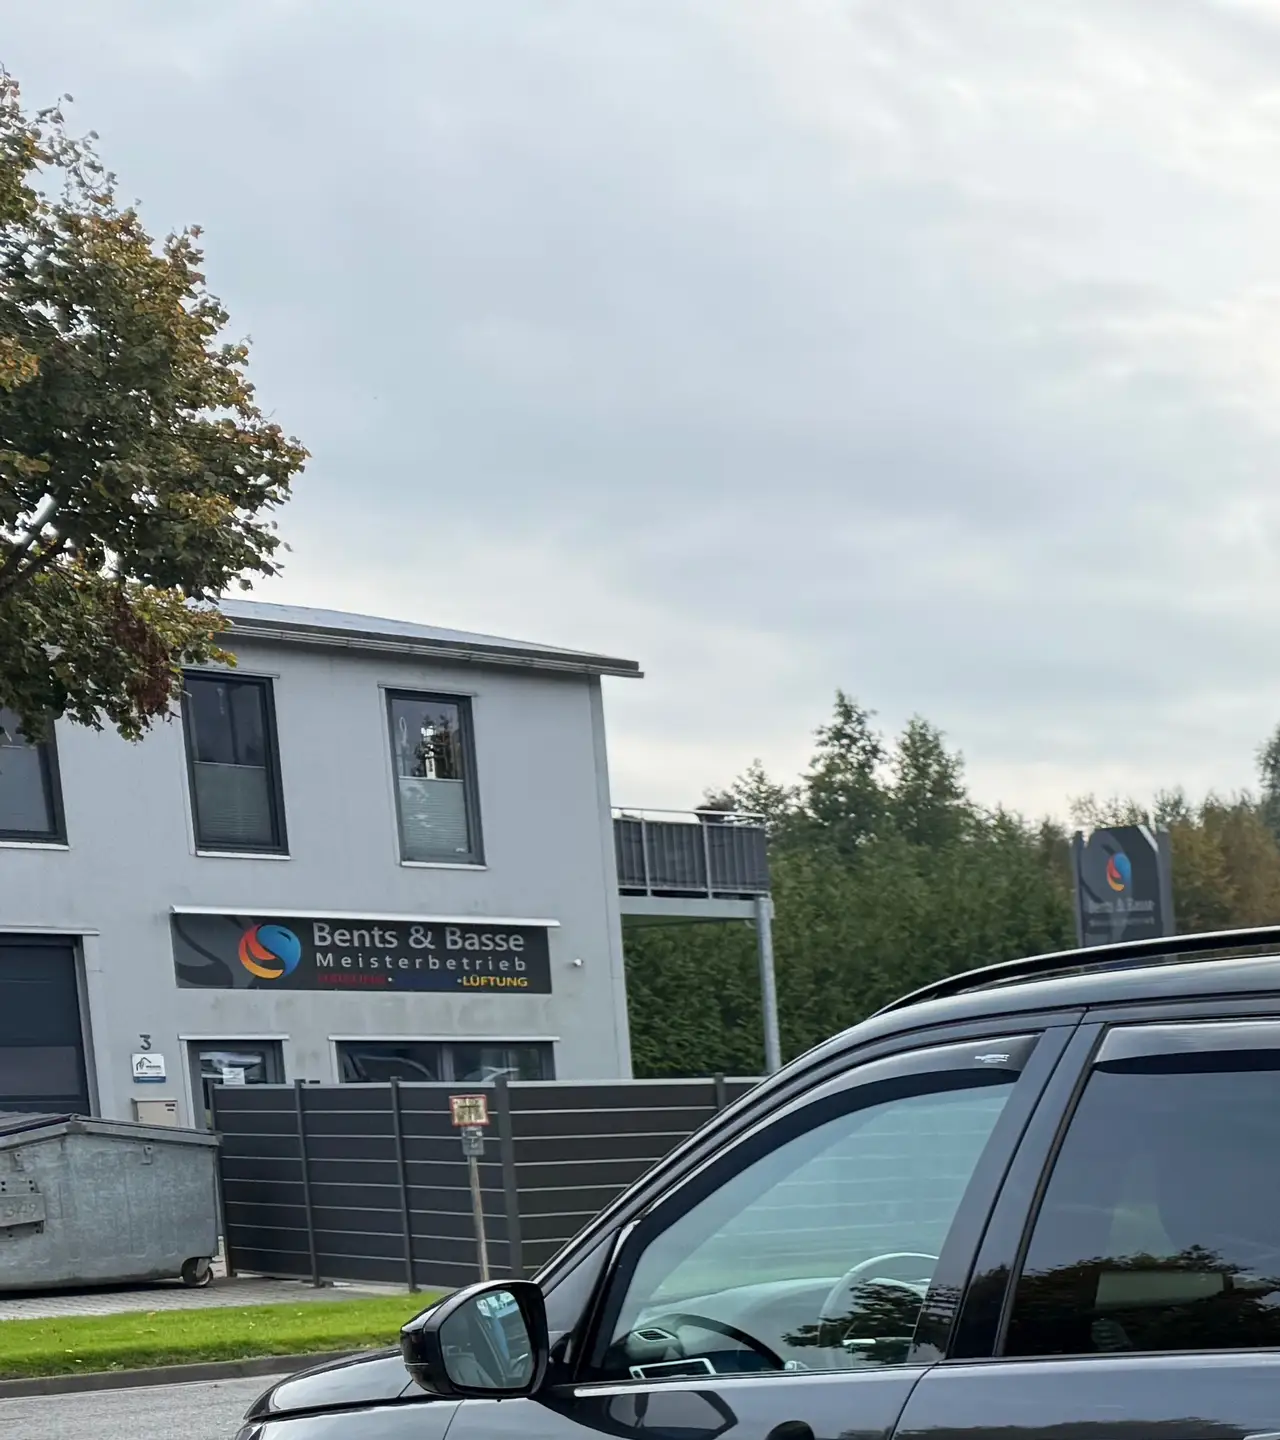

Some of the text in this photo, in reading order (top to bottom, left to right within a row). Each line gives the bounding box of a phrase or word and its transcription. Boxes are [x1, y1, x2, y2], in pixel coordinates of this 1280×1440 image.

[313, 922, 525, 952] Bents & Basse
[316, 952, 526, 971] Meisterbetrieb
[463, 974, 529, 987] LÜFTUNG
[139, 1034, 152, 1051] 3
